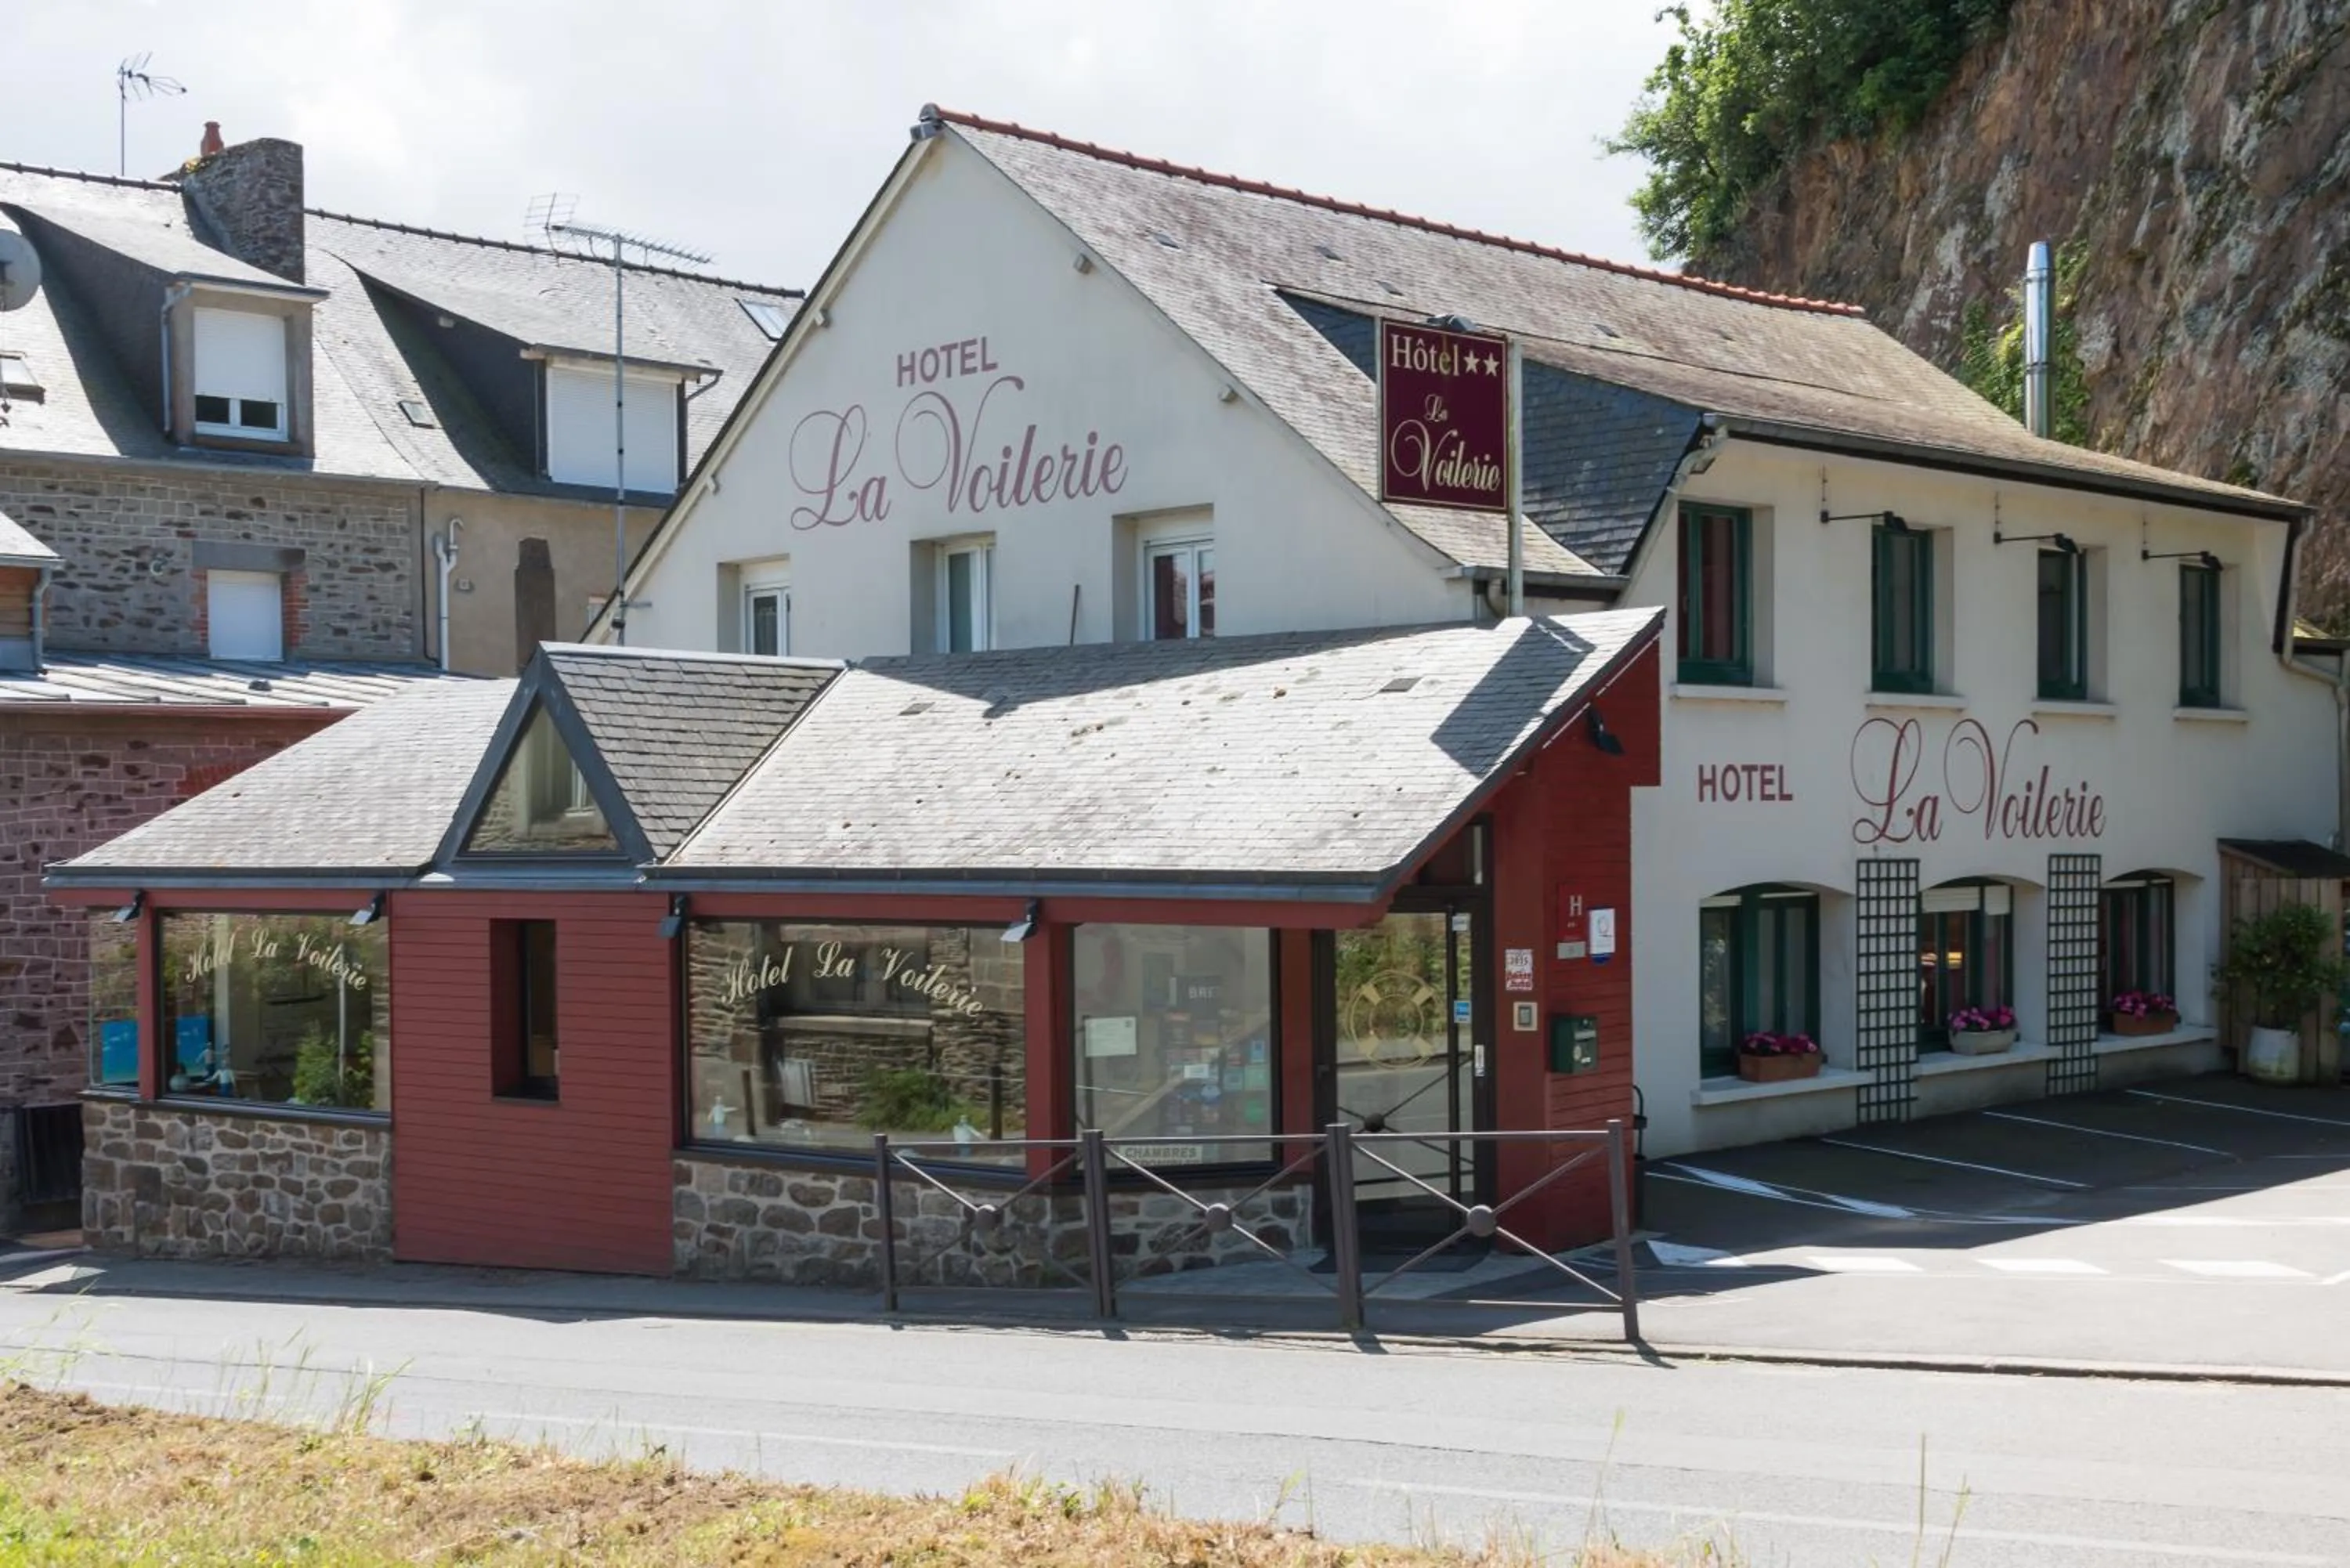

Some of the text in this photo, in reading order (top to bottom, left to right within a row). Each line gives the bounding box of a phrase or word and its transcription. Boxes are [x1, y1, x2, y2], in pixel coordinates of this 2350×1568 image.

[896, 337, 998, 387] HOTEL
[1390, 333, 1460, 377] Hôtel
[1423, 394, 1448, 422] La
[790, 376, 1128, 530] La Voilerie
[1390, 419, 1501, 491] Voilerie
[1697, 764, 1793, 803] HOTEL
[1850, 717, 2106, 844] La Voilerie
[1570, 895, 1582, 916] H
[185, 929, 368, 992] Hotel La Voilerie
[721, 940, 984, 1018] Hotel La Voilerie
